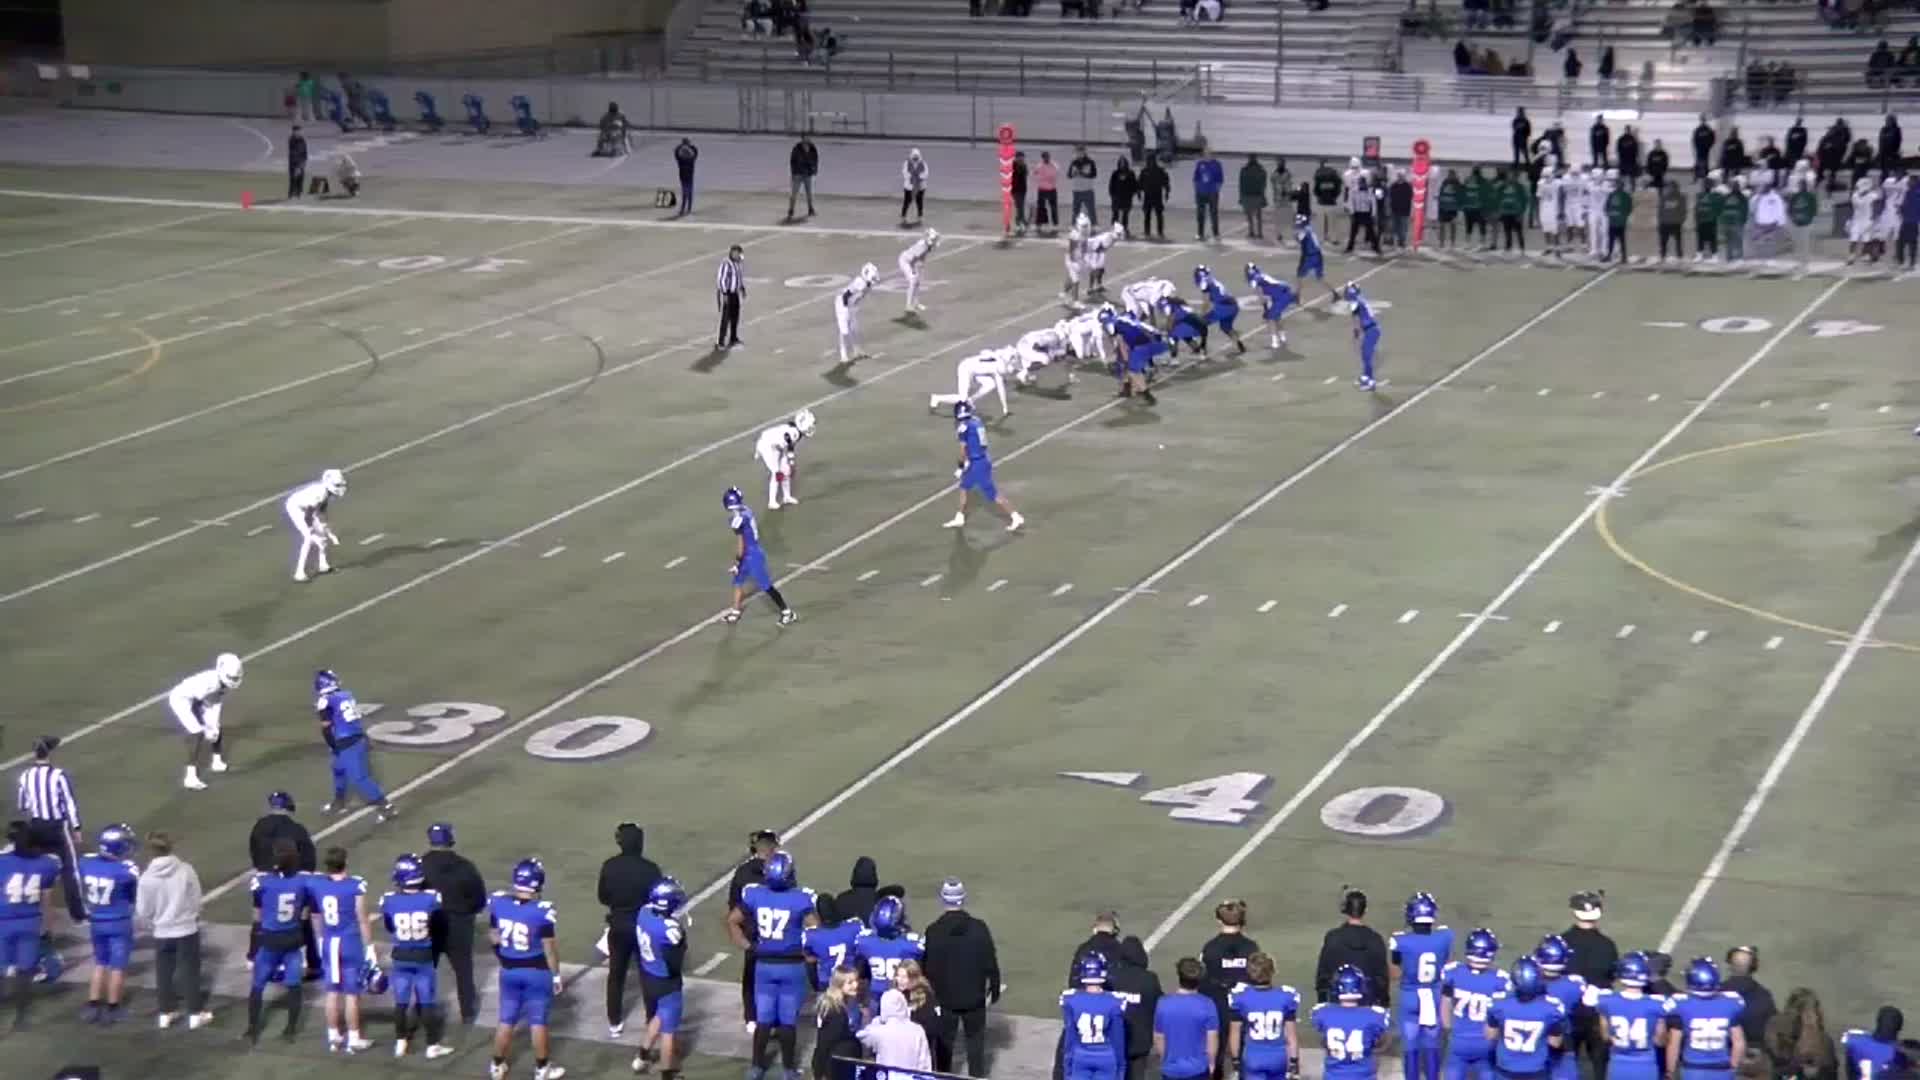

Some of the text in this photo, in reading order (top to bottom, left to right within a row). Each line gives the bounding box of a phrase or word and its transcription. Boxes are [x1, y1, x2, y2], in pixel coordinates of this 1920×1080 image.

[1140, 772, 1444, 835] 40
[6, 873, 41, 903] 44
[84, 877, 115, 904] 37
[276, 893, 296, 922] 5
[322, 896, 339, 926] 8
[757, 906, 790, 941] 97
[829, 944, 847, 971] 7
[1418, 952, 1437, 983] 6
[1454, 987, 1488, 1021] 70
[1077, 1013, 1106, 1044] 41
[1248, 1010, 1283, 1040] 30
[1504, 1020, 1544, 1052] 57
[1611, 1017, 1648, 1050] 34
[1690, 1018, 1728, 1049] 25
